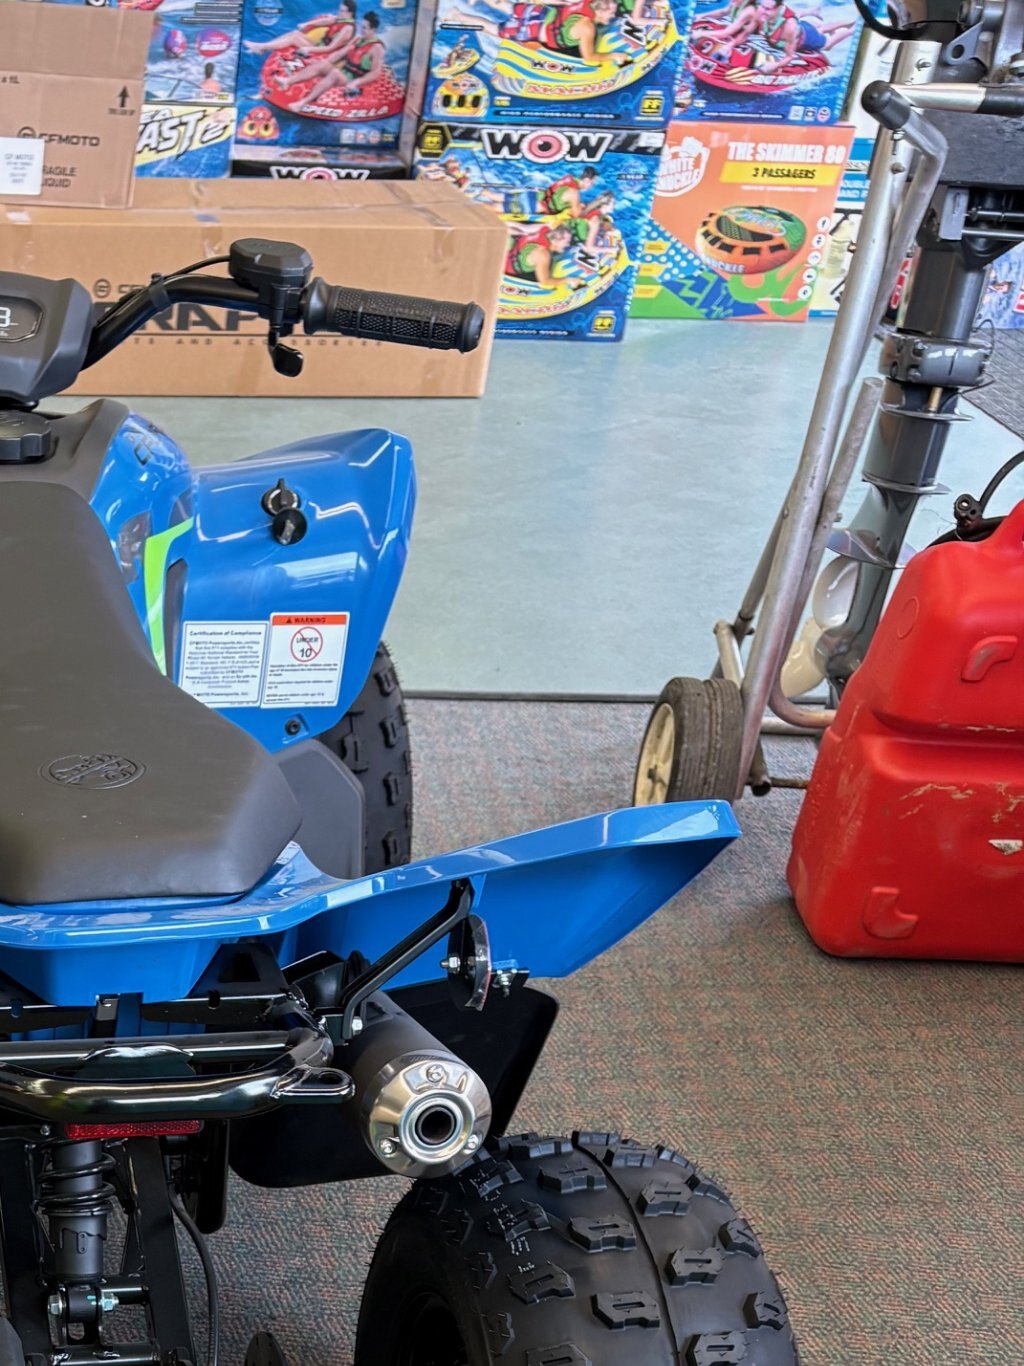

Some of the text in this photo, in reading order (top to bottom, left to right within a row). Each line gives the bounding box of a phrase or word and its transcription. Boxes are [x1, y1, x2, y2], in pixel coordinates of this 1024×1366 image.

[346, 105, 389, 118] ZILLA
[38, 133, 100, 147] CFMOTO
[136, 109, 207, 160] AST
[481, 129, 613, 163] WOW
[728, 142, 755, 161] THE
[756, 143, 825, 163] SKIMMER
[41, 177, 71, 188] IQUID
[233, 337, 383, 346] ACCSSORIES
[299, 648, 313, 658] 10
